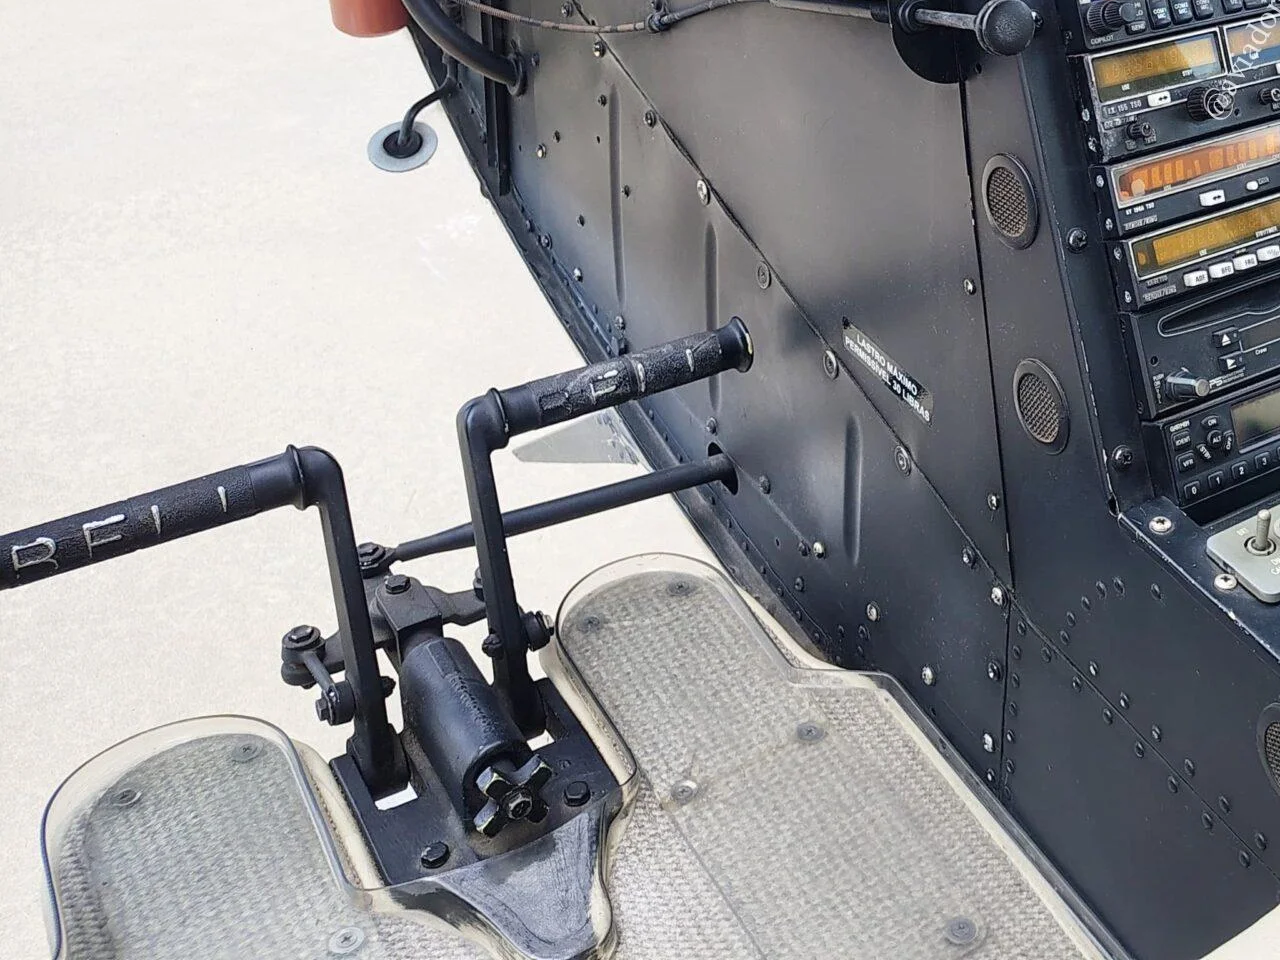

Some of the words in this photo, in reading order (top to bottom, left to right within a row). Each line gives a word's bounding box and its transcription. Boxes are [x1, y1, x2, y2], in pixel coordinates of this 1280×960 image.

[1091, 35, 1114, 45] COPILOT
[857, 334, 886, 367] LASTRO
[893, 380, 901, 394] 30
[902, 389, 930, 421] LIBRAS
[1207, 417, 1217, 426] ON
[1175, 434, 1191, 447] IDENT
[1212, 435, 1222, 444] ALT
[1183, 458, 1194, 468] VFR
